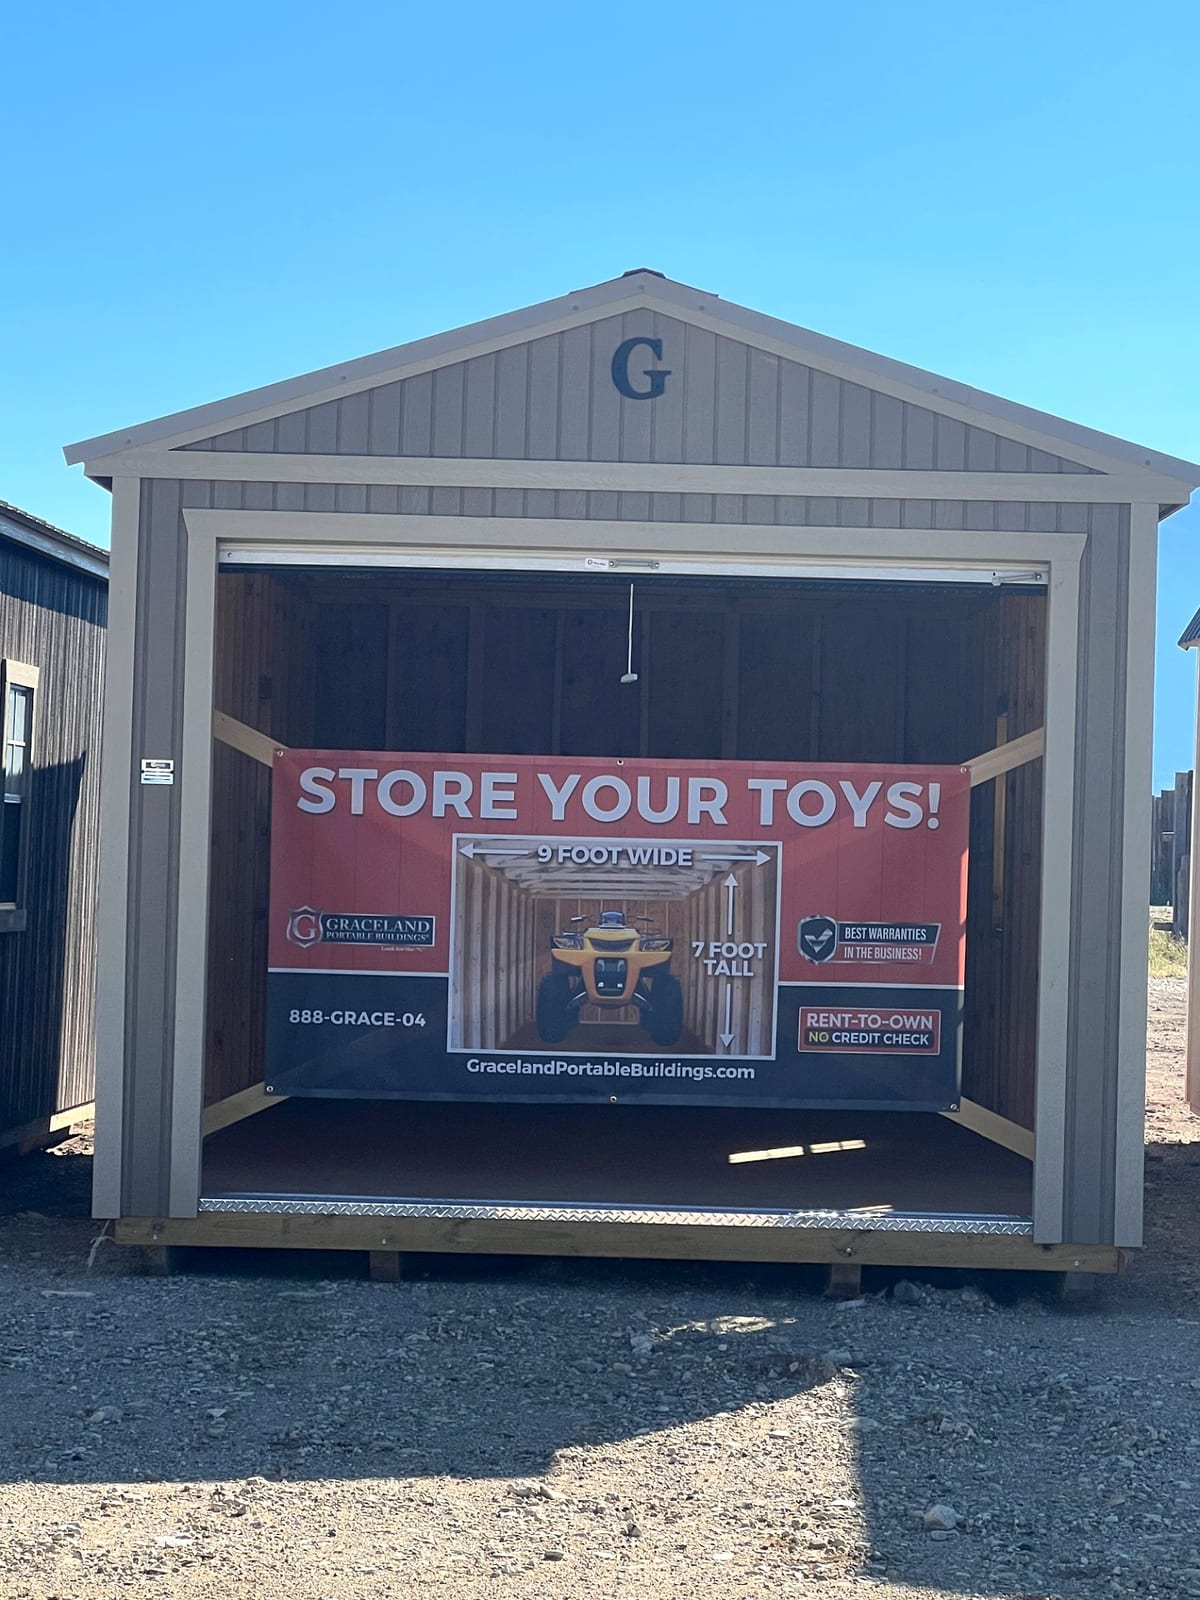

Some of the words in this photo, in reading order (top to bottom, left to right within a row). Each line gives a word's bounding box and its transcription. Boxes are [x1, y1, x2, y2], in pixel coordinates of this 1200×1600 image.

[611, 337, 672, 400] G
[297, 767, 518, 819] STORE
[537, 774, 728, 825] YOUR
[748, 779, 941, 830] TOYS!
[537, 845, 552, 863] 9
[558, 846, 622, 864] FOOT
[627, 848, 693, 866] WIDE
[292, 914, 317, 940] G
[326, 918, 430, 933] GRACELAND
[845, 927, 867, 940] BEST
[868, 928, 927, 941] WARRANTIES
[326, 931, 375, 940] PORTABLE
[692, 942, 705, 957] 7
[709, 942, 767, 959] FOOT
[844, 947, 854, 959] IN
[856, 947, 873, 959] THE
[875, 948, 922, 960] BUSINESS!
[704, 960, 754, 976] TALL
[289, 1009, 426, 1027] 888-GRACE-04
[807, 1013, 933, 1030] RENT-TO-OWN
[809, 1032, 829, 1043] NO
[832, 1032, 881, 1044] CREDIT
[883, 1034, 929, 1045] CHECK
[466, 1059, 755, 1080] GracelandPortableBuildings.com
